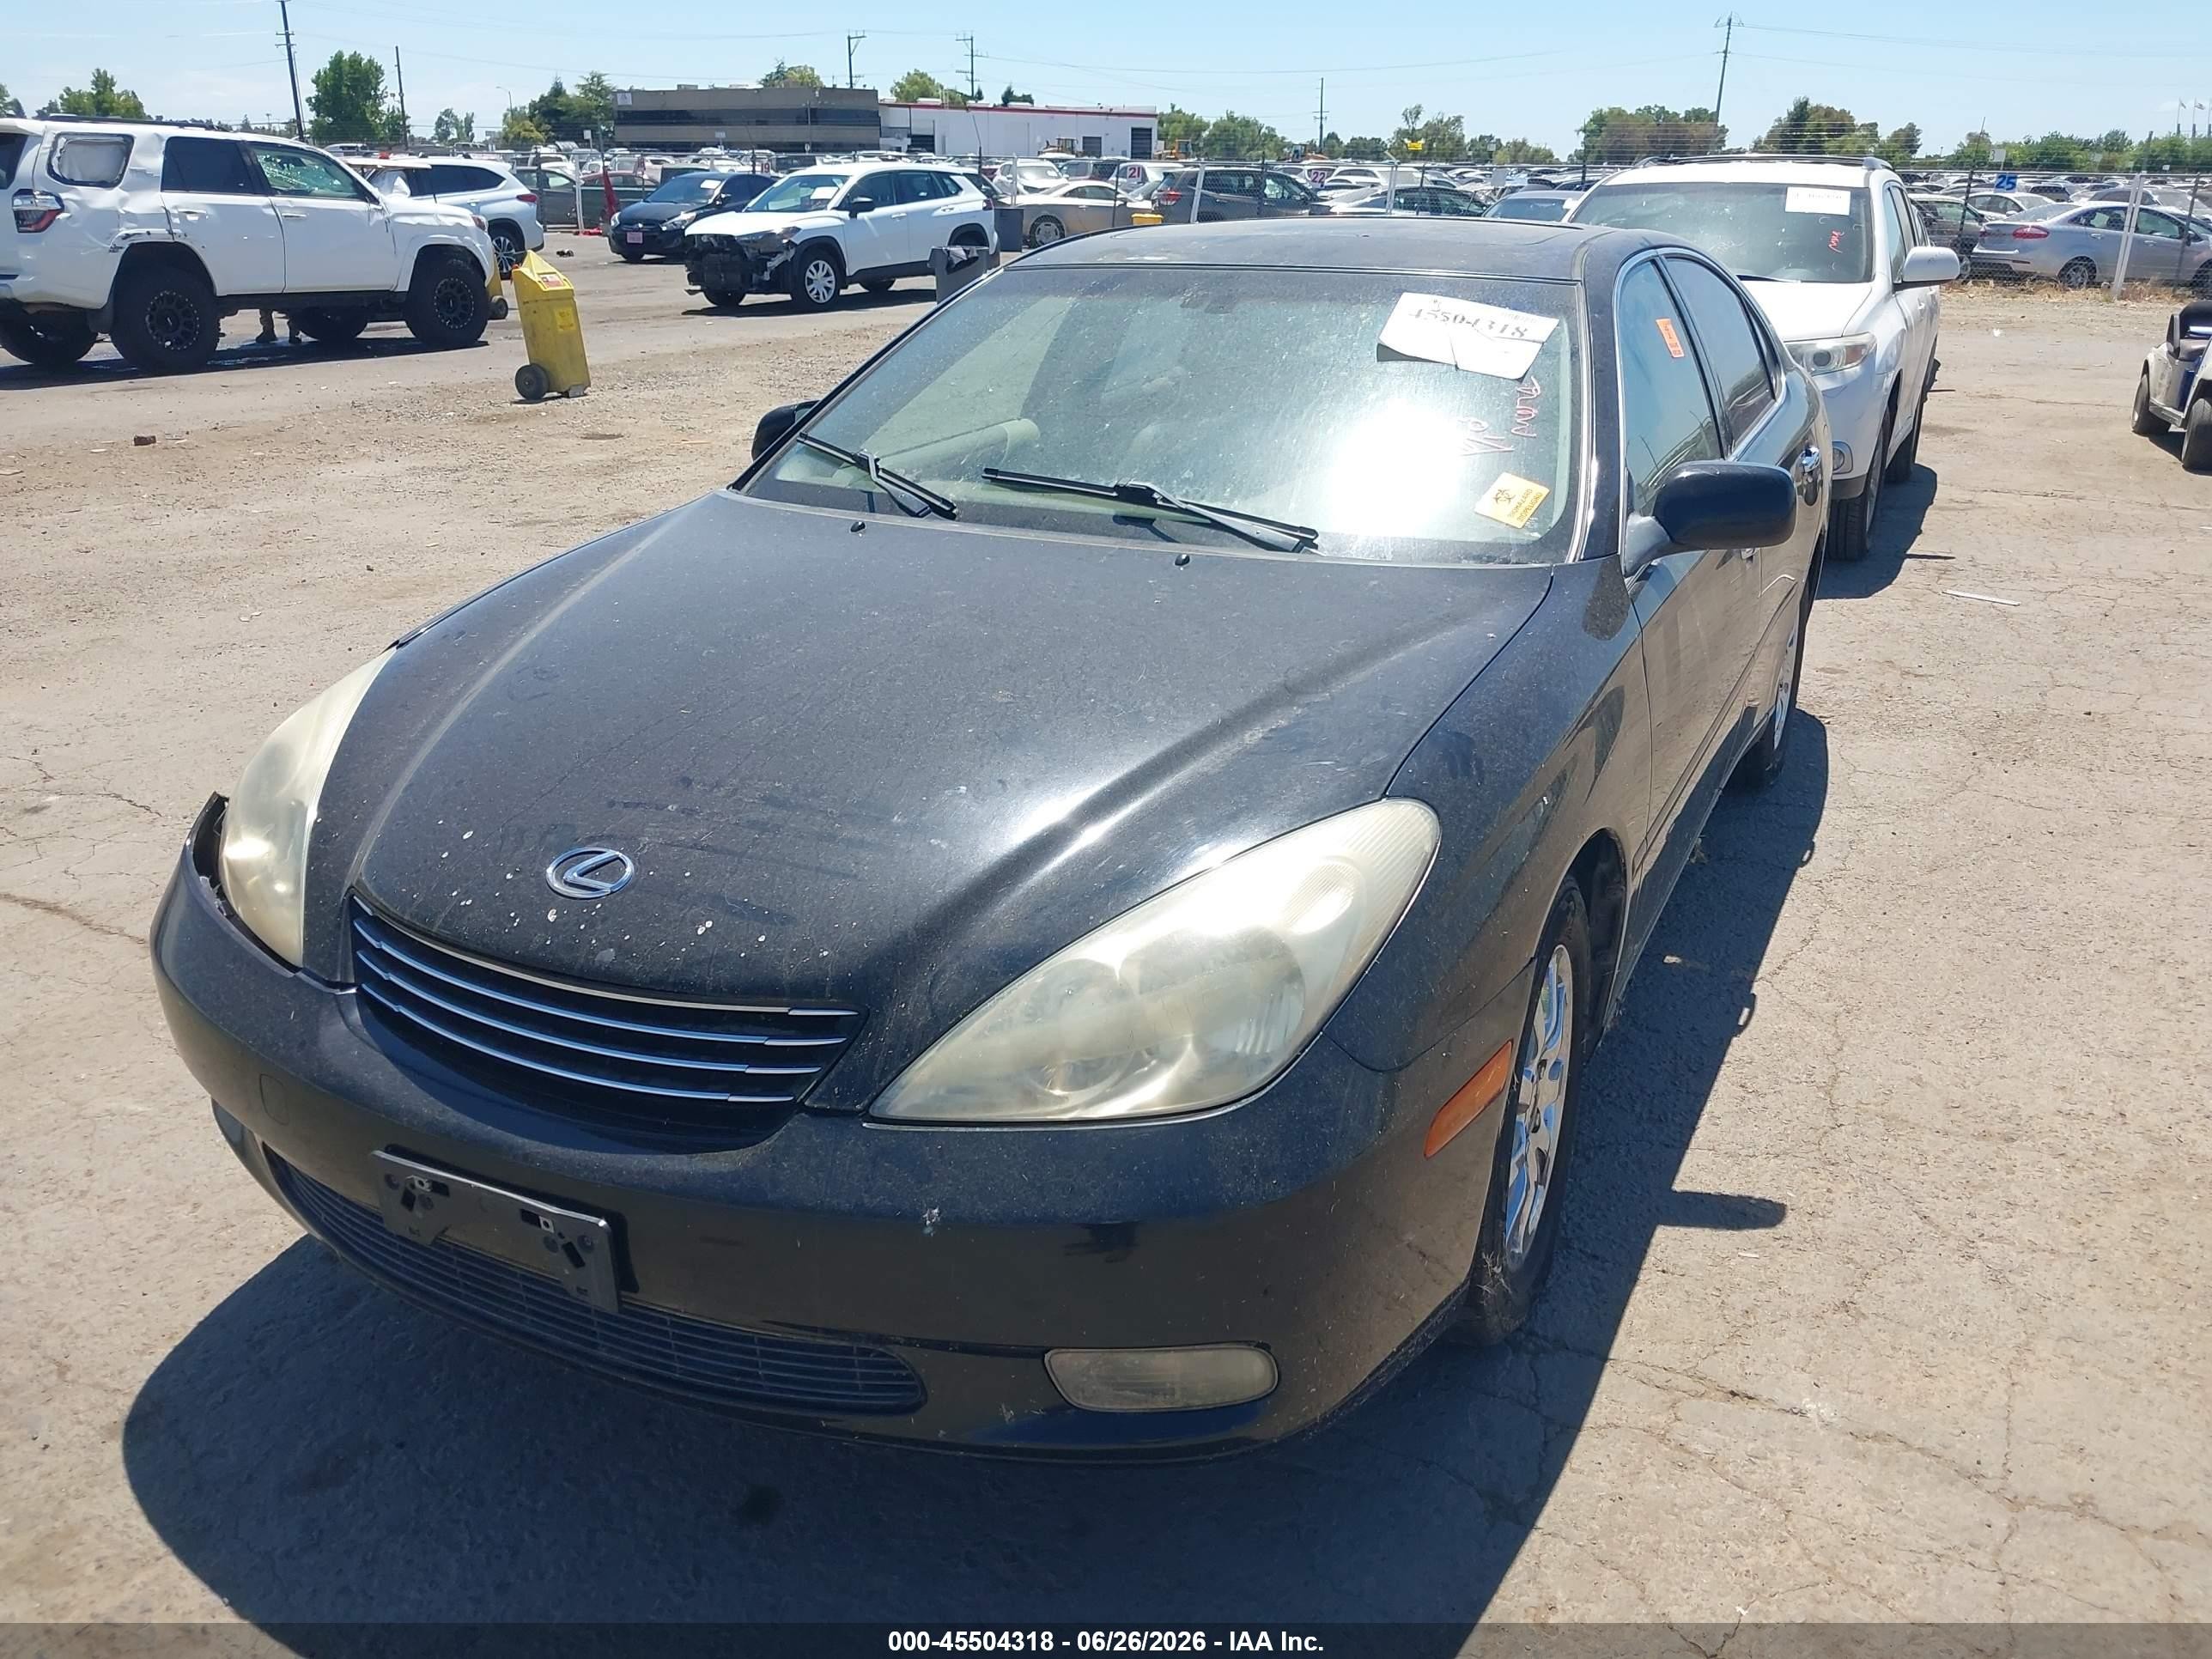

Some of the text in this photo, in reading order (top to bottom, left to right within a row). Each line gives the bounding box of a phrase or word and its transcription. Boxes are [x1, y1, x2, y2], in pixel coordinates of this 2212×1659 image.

[1127, 167, 1141, 179] 21
[1311, 172, 1326, 184] 22
[1995, 174, 2017, 191] 25
